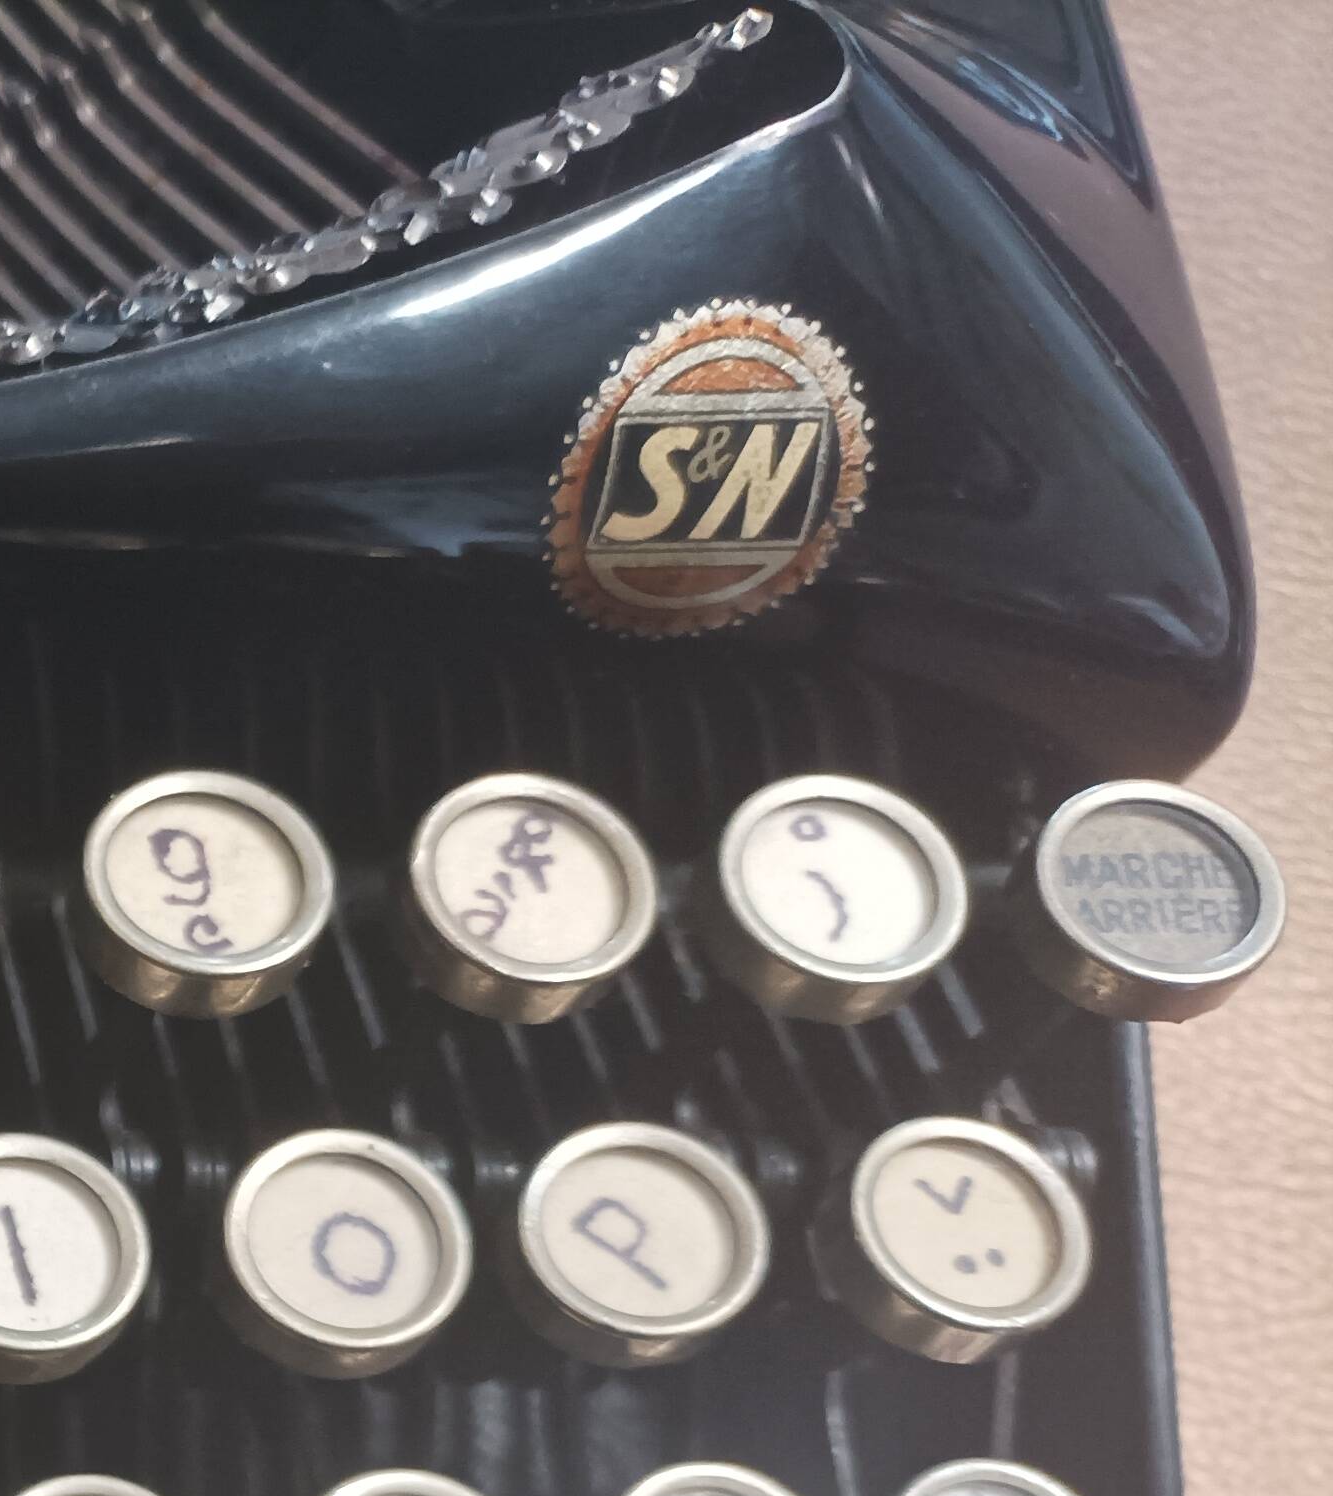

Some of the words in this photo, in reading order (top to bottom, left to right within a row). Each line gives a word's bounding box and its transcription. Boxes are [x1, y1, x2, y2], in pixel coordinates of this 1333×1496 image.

[601, 422, 818, 541] S&N
[311, 1212, 397, 1297] O
[571, 1197, 668, 1291] P
